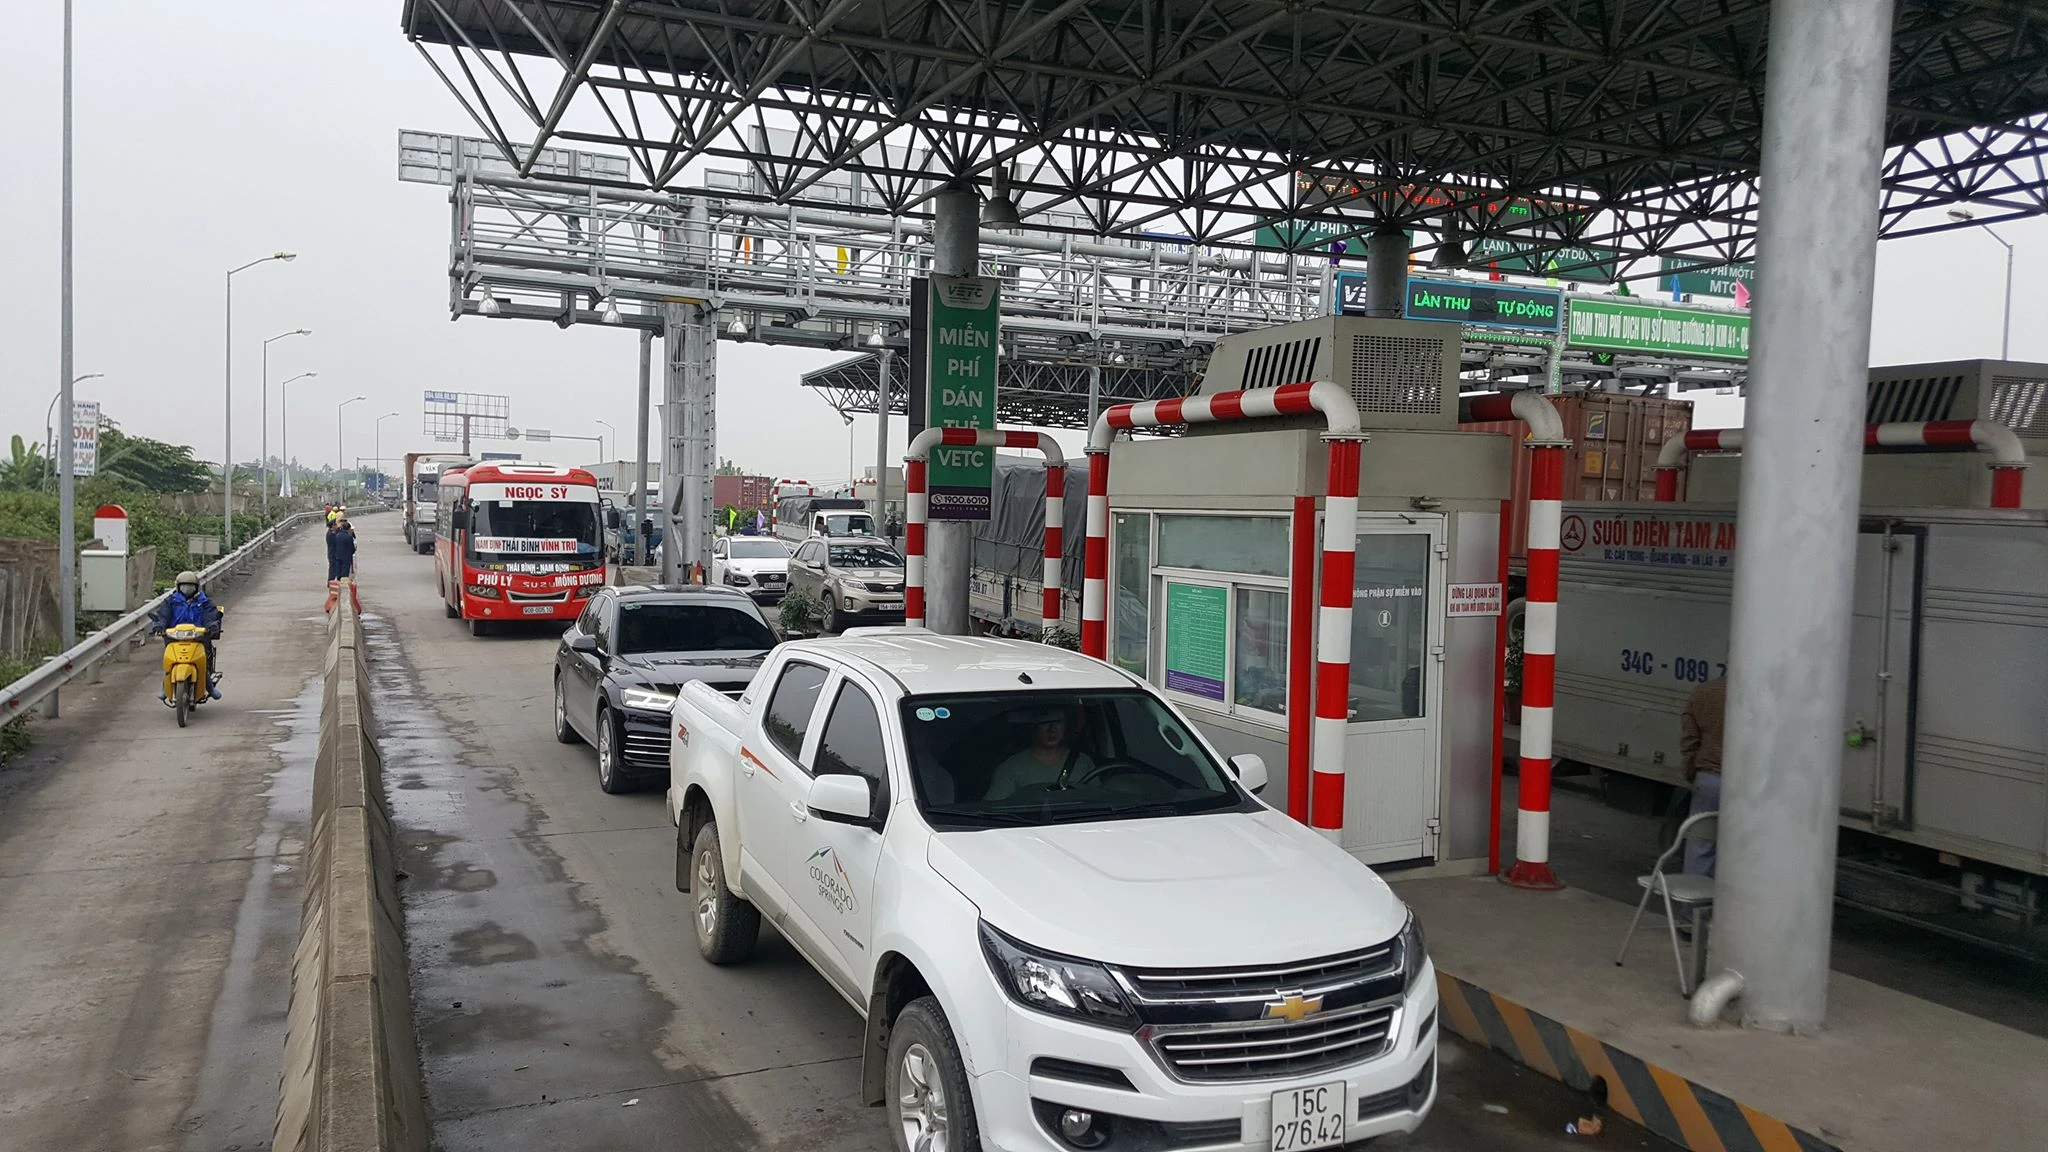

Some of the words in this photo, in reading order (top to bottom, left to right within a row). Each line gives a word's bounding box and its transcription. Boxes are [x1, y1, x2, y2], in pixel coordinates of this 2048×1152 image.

[1414, 290, 1441, 309] LÀN
[1443, 296, 1471, 311] THU
[1497, 300, 1514, 317] TỰ
[1516, 299, 1554, 319] ĐỘNG
[940, 322, 989, 348] MIỄN
[1573, 311, 1593, 340] TRẠM
[1595, 313, 1608, 338] THU
[1609, 311, 1622, 339] PHÍ
[1623, 315, 1640, 344] DỊCH
[1641, 317, 1651, 346] VỤ
[948, 356, 981, 377] PHÍ
[942, 385, 983, 408] DÁN
[938, 449, 985, 468] VETC
[505, 487, 544, 500] NGỌC
[551, 486, 568, 499] SỸ
[944, 496, 988, 505] 1900.6010
[502, 538, 519, 552] THÁI
[521, 538, 540, 552] BÌNH
[1676, 521, 1712, 549] TAM
[500, 571, 513, 587] LÝ
[1621, 648, 1654, 676] 34C
[1675, 656, 1709, 683] 089
[810, 866, 853, 911] COLORADO
[819, 885, 844, 914] SPRINGS
[1292, 1087, 1328, 1118] 15C
[1274, 1113, 1342, 1151] 276.42
